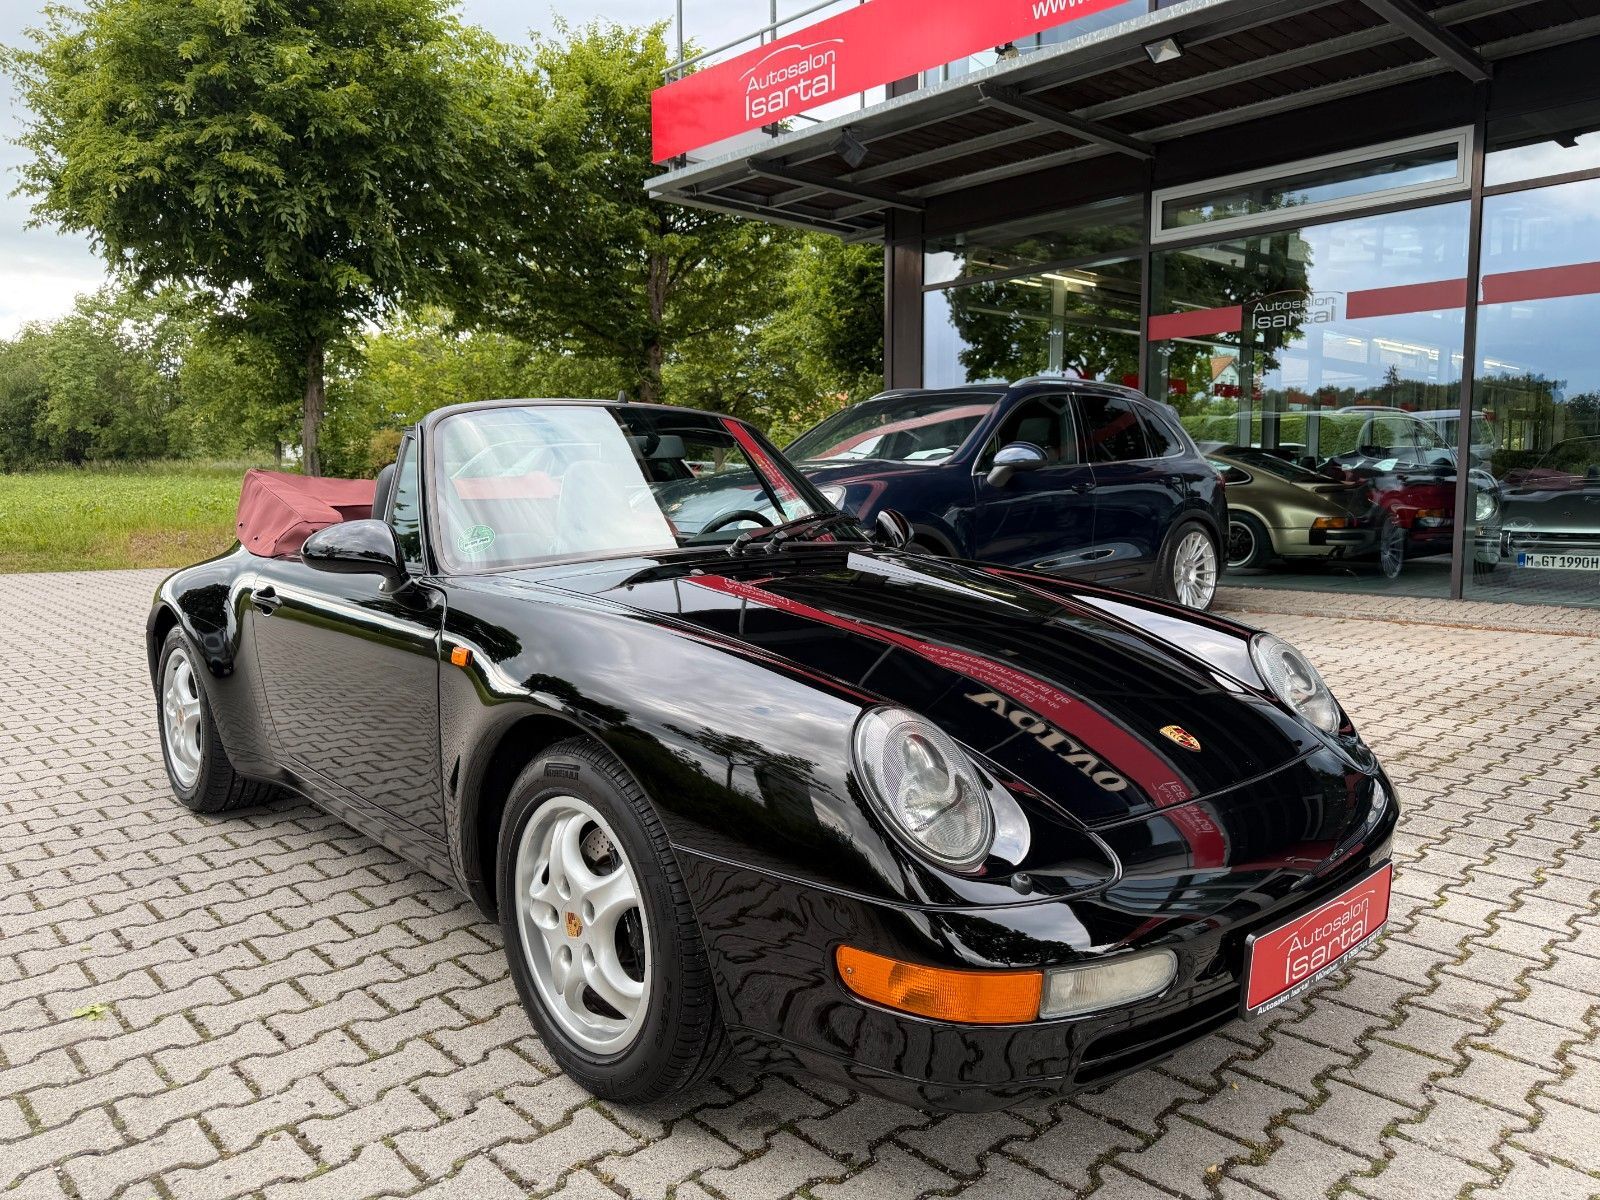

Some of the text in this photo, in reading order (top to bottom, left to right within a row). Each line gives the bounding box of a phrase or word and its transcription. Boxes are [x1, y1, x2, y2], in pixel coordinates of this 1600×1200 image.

[745, 64, 835, 121] Isartal
[746, 50, 835, 94] Autosalon
[1252, 305, 1336, 329] Isartal
[1253, 297, 1336, 313] Autosalon
[1526, 555, 1534, 566] M
[1541, 556, 1557, 567] GT
[1285, 908, 1369, 984] Isartal
[1288, 897, 1369, 956] Autosalon
